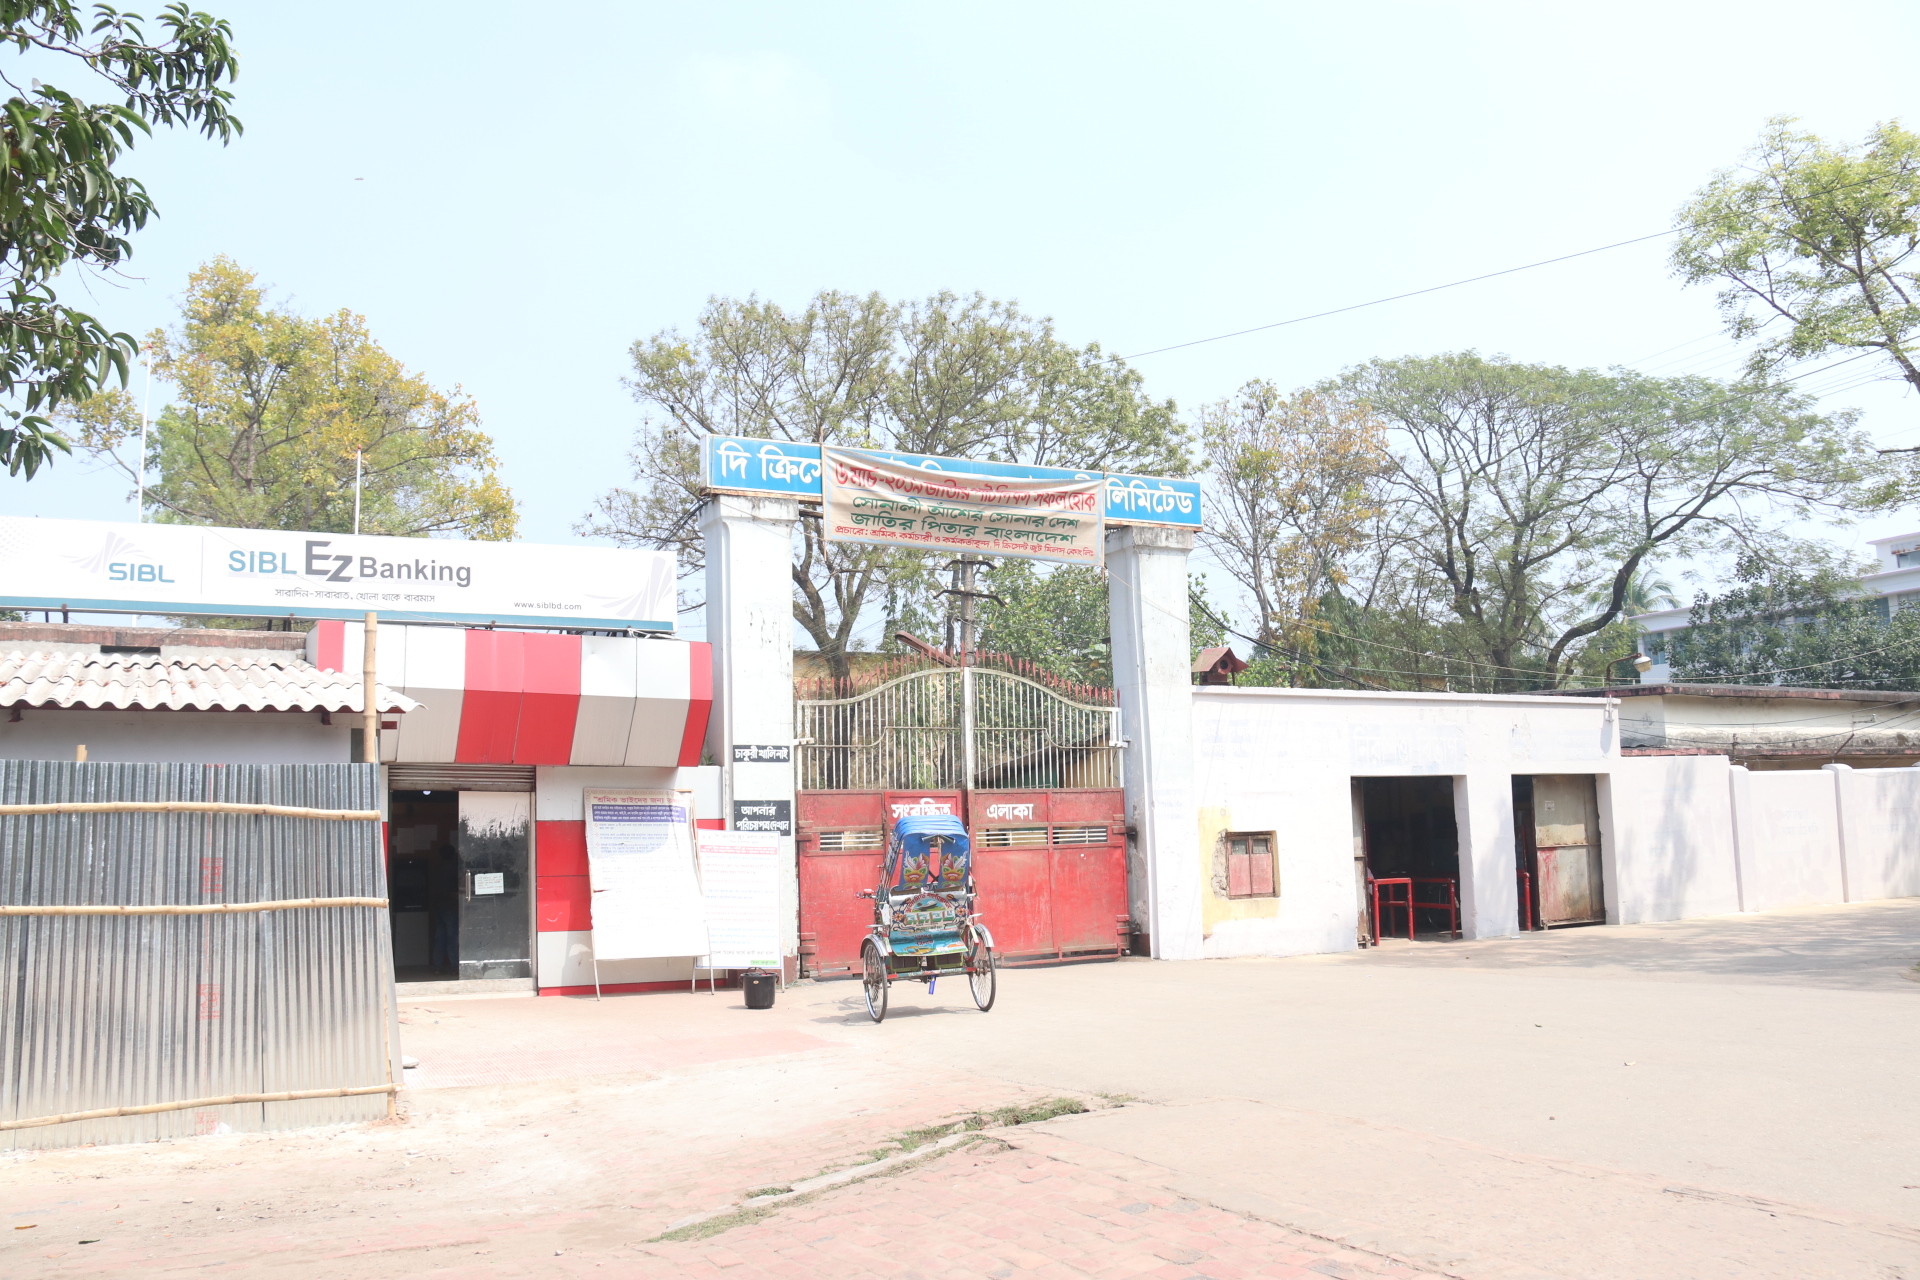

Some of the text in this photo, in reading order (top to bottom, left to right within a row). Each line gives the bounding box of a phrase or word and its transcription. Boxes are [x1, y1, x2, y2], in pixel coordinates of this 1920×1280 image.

[716, 441, 752, 479] দি
[1105, 477, 1195, 514] লিমিটেড
[1068, 491, 1095, 511] হোক
[853, 496, 1080, 529] সোনালী আঁশের সোনার দেশ
[850, 510, 1077, 545] জাতির পিতার বাংলাদেশ
[899, 531, 932, 542] কর্মচারী
[109, 562, 175, 583] SIBL
[228, 540, 471, 588] SIBL Ez Banking
[356, 592, 379, 601] খোলা
[404, 594, 435, 603] বারমাস
[514, 602, 582, 610] www.siblbd.com
[741, 805, 776, 817] আপনার
[986, 803, 1034, 821] এলাকা
